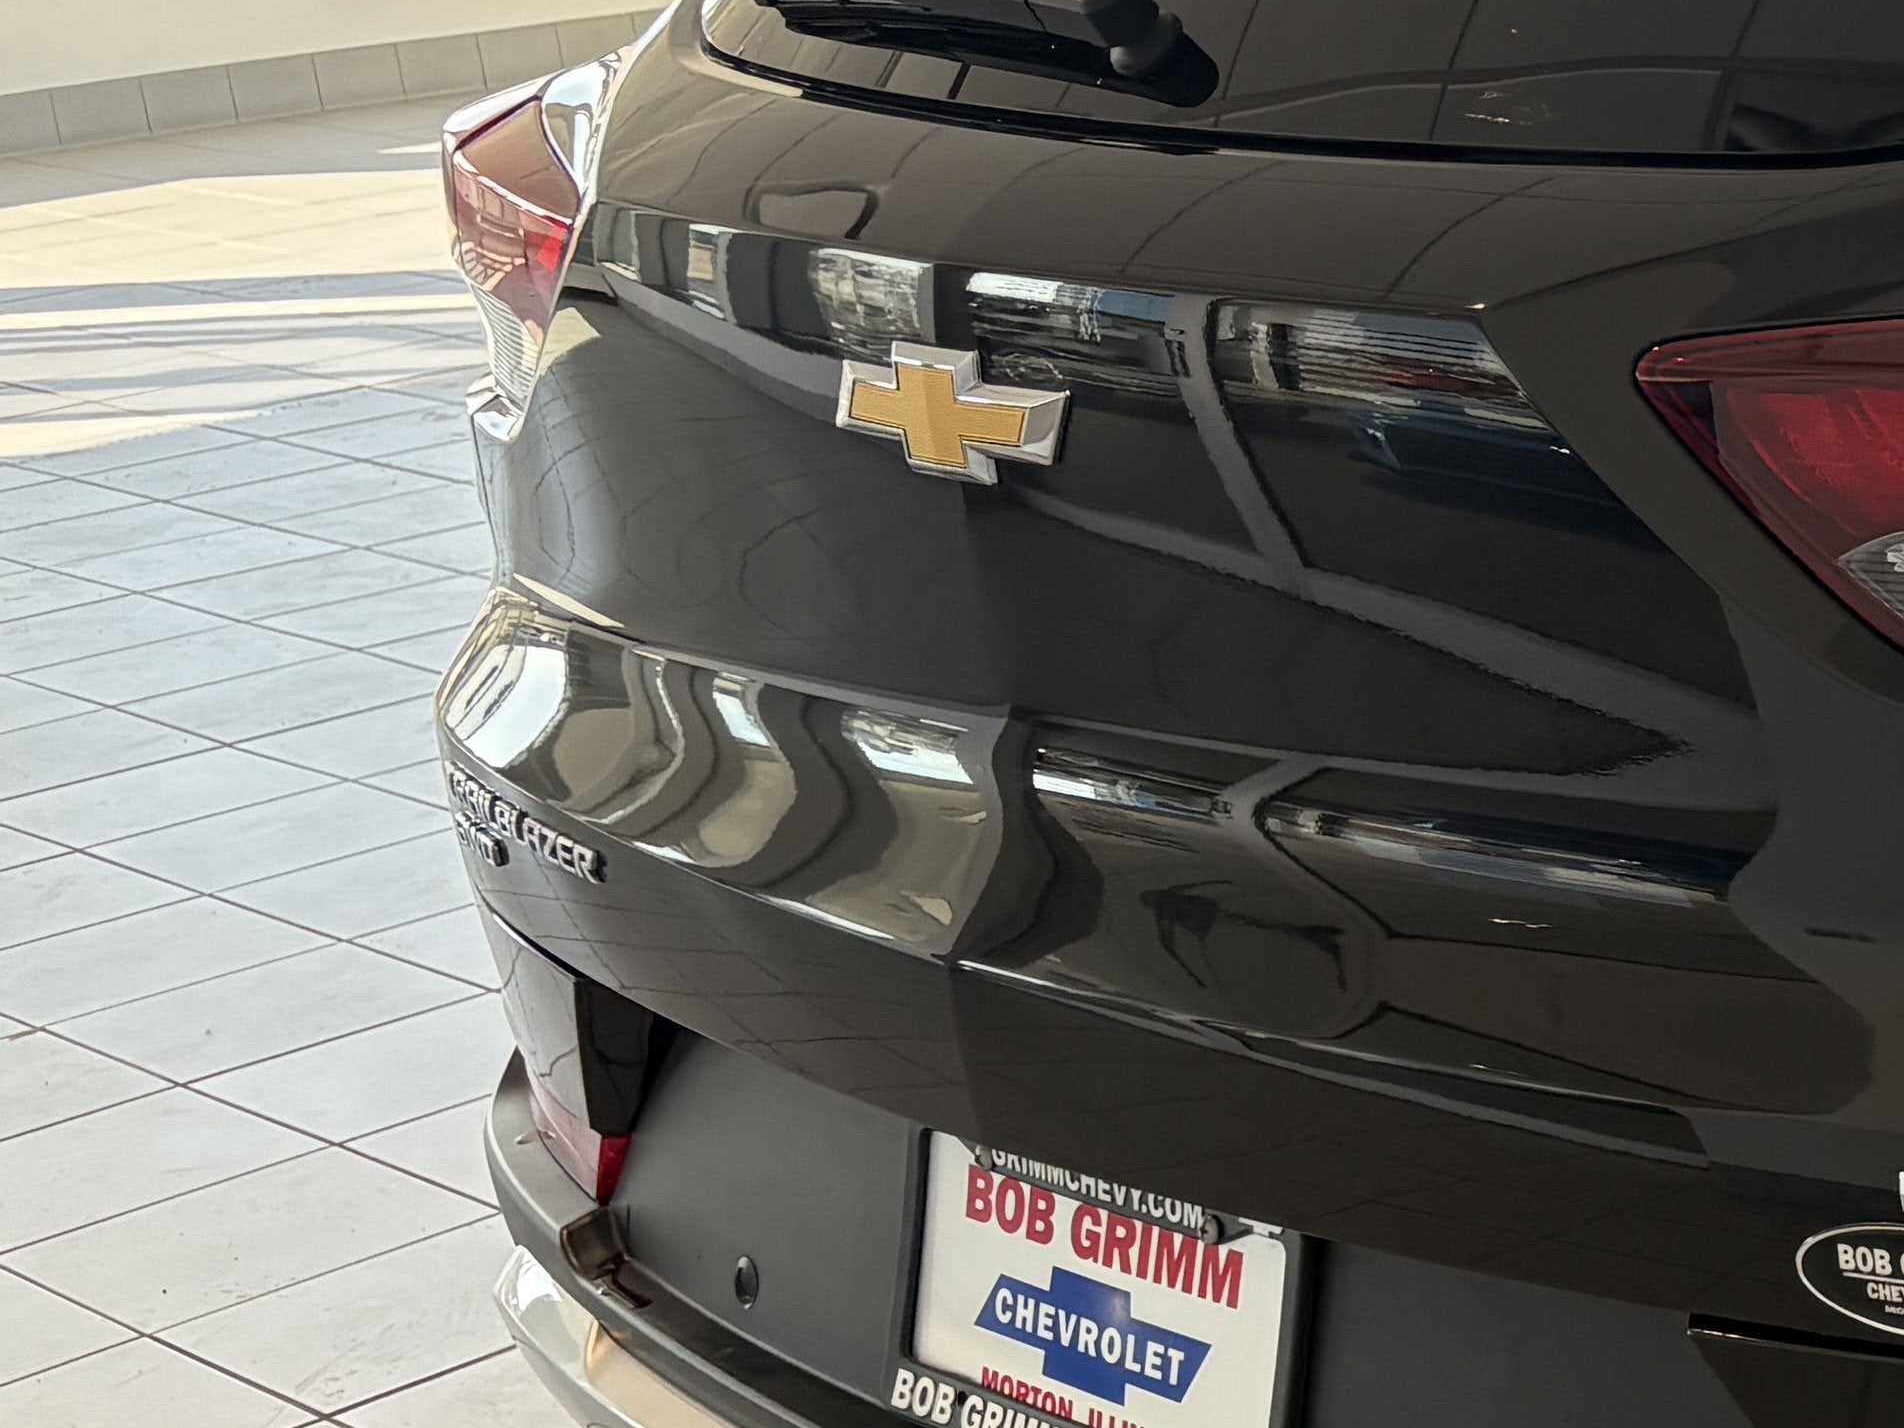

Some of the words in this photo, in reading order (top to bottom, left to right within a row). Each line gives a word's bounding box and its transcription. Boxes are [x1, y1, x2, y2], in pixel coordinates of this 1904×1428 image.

[443, 760, 602, 884] TRAILBLAZER
[991, 1147, 1205, 1229] GRIMMCHEVY.COM
[966, 1163, 1056, 1246] BOB
[1070, 1202, 1244, 1309] GRIMM
[1837, 1242, 1893, 1276] BOB
[994, 1286, 1186, 1387] CHEVROLET
[890, 1368, 957, 1425] BOB
